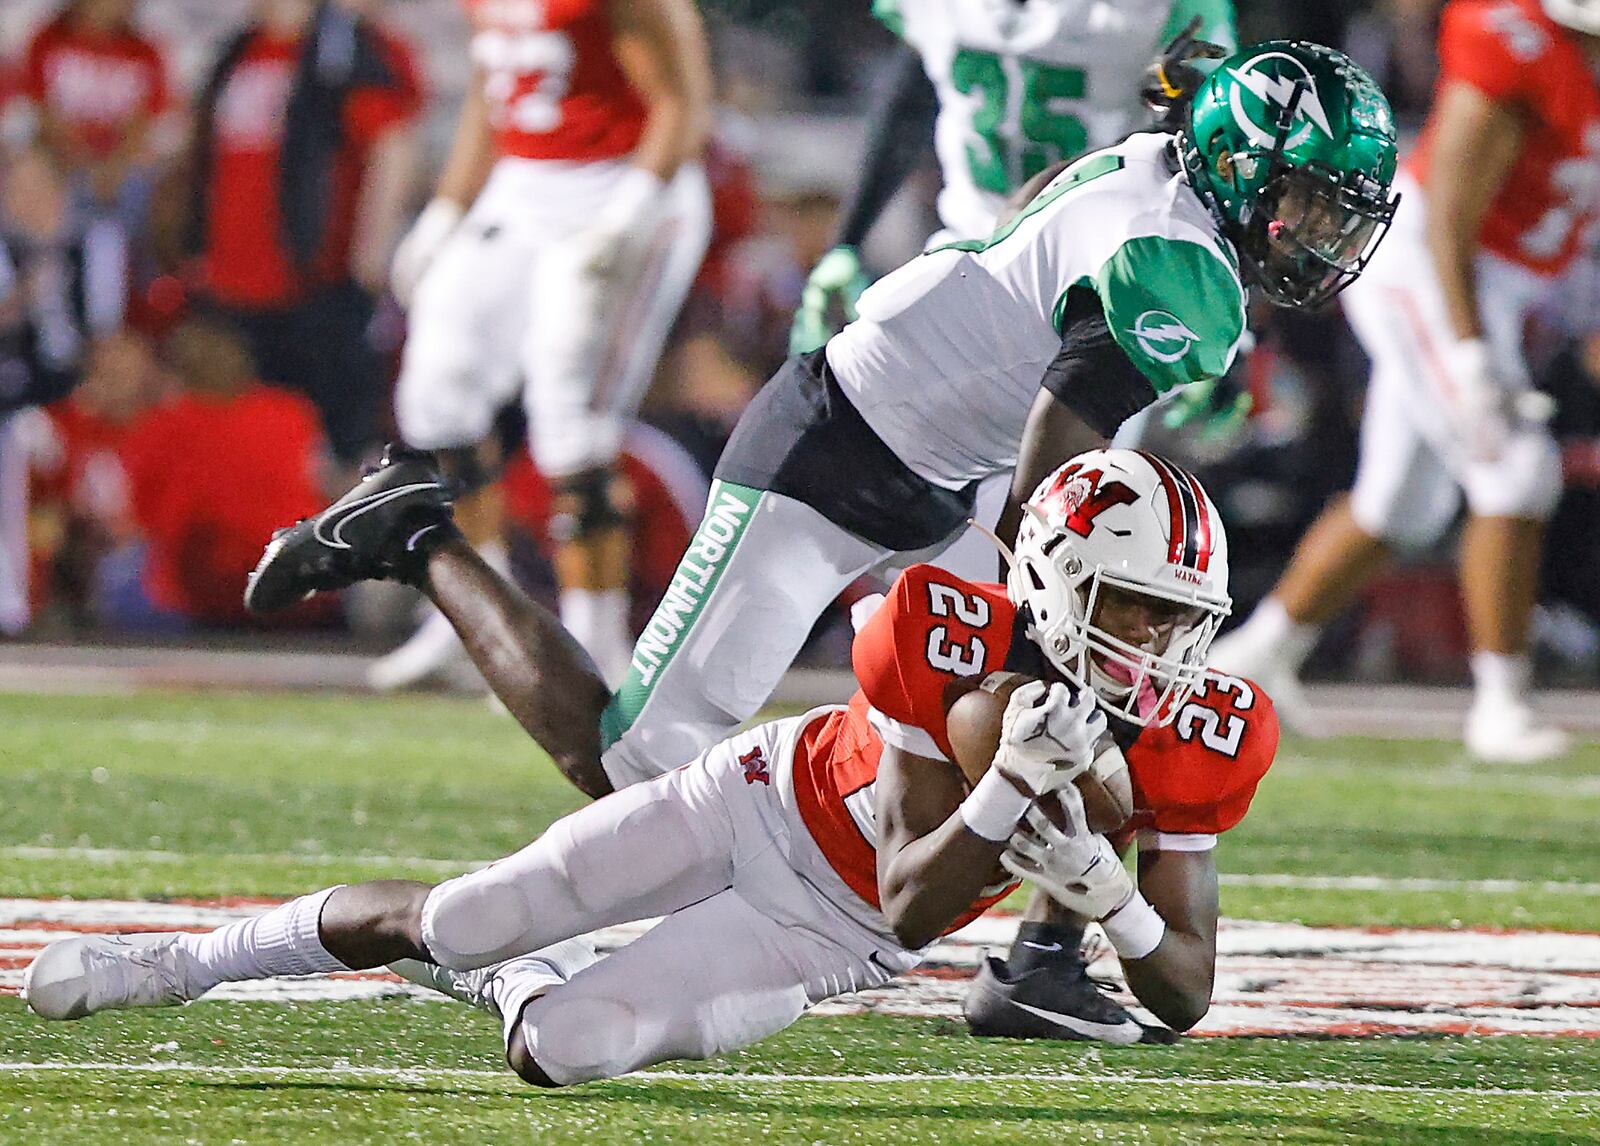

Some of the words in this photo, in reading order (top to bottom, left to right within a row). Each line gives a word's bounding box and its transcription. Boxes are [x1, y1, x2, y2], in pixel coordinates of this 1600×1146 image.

[952, 48, 1088, 194] 35
[632, 492, 750, 687] NORTHMONT
[927, 582, 989, 677] 23
[1176, 671, 1254, 758] 23
